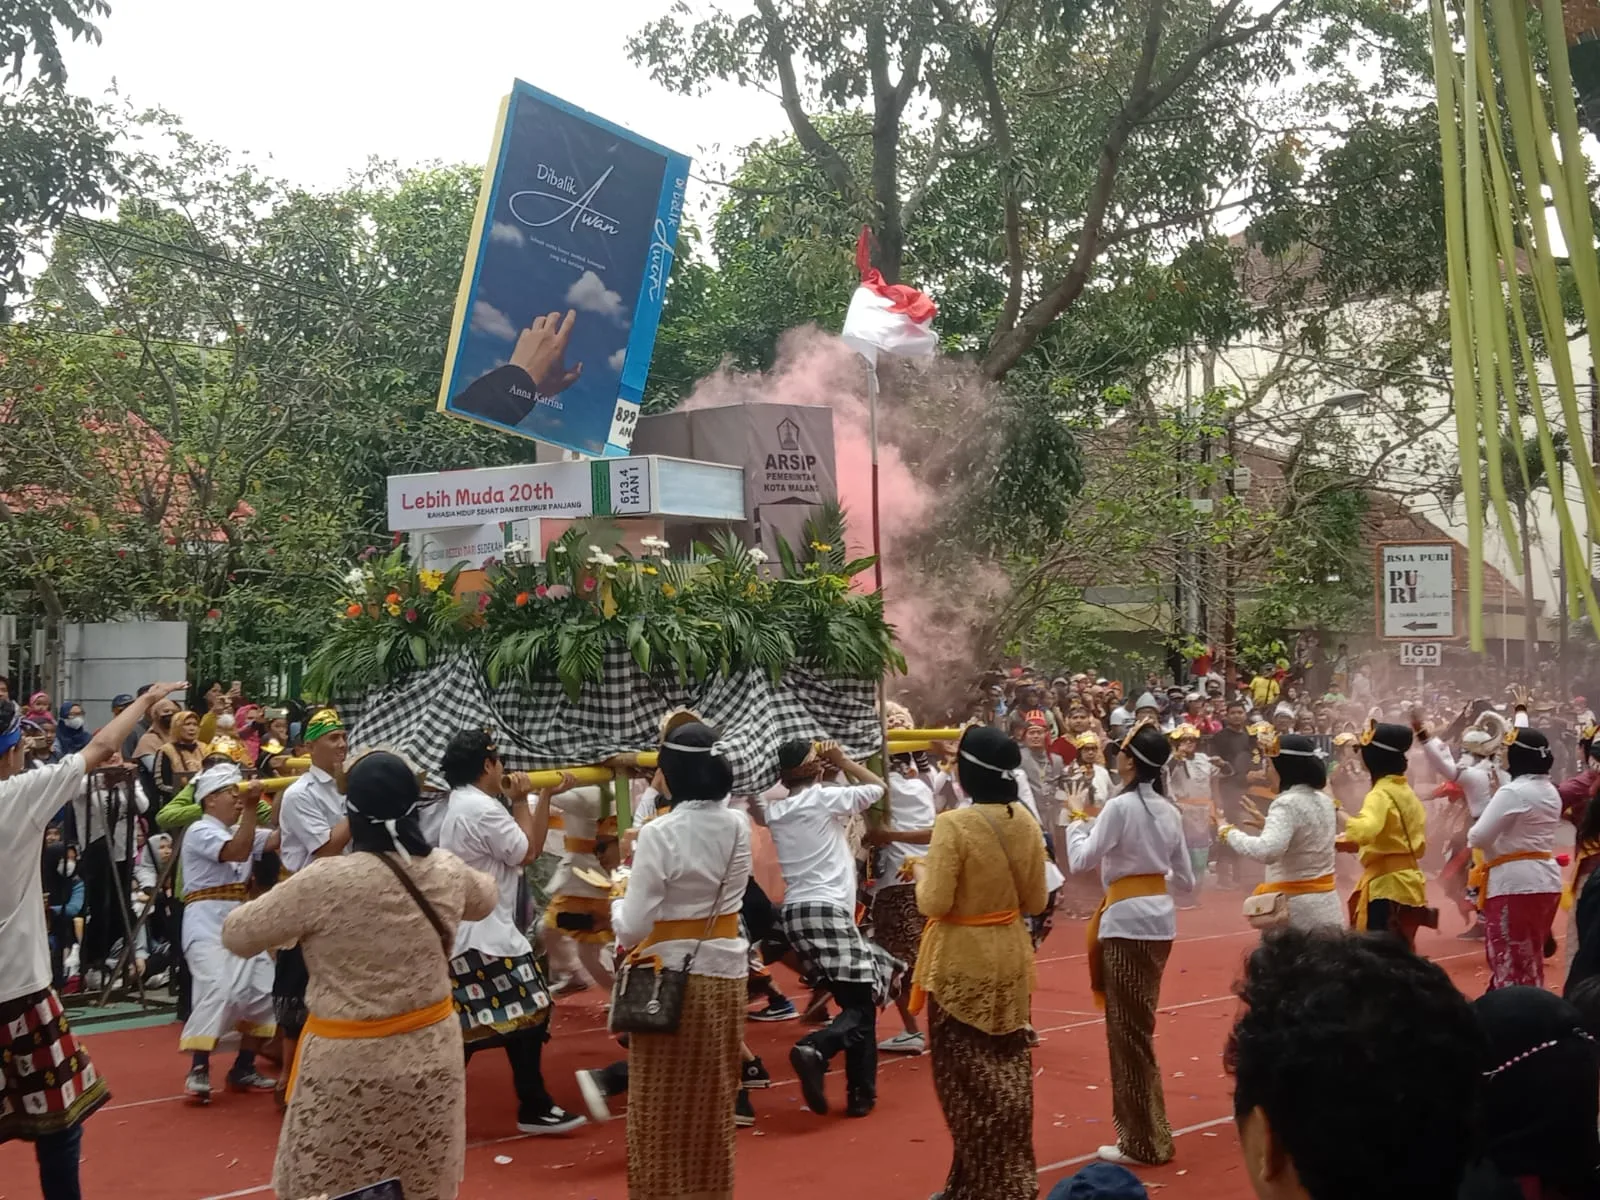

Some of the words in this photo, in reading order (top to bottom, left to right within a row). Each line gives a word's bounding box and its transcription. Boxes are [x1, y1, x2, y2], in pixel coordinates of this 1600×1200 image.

[536, 164, 577, 195] Dibalik
[509, 165, 620, 235] Awan
[509, 384, 532, 400] Anna
[534, 391, 564, 410] Katrina
[616, 406, 636, 424] 899
[765, 454, 817, 470] ARSIP
[620, 469, 630, 504] 613.4
[630, 476, 639, 504] HAN
[764, 484, 786, 492] KOTA
[402, 490, 450, 510] Lebih
[456, 486, 505, 506] Muda
[509, 482, 554, 502] 20th
[476, 507, 499, 515] SEHAT
[500, 506, 514, 514] DAN
[515, 504, 548, 513] BERUMUR
[548, 501, 582, 510] PANJANG
[1420, 553, 1449, 562] PURI
[1389, 570, 1418, 587] PU
[1390, 587, 1417, 604] RI
[1405, 645, 1437, 657] IGD
